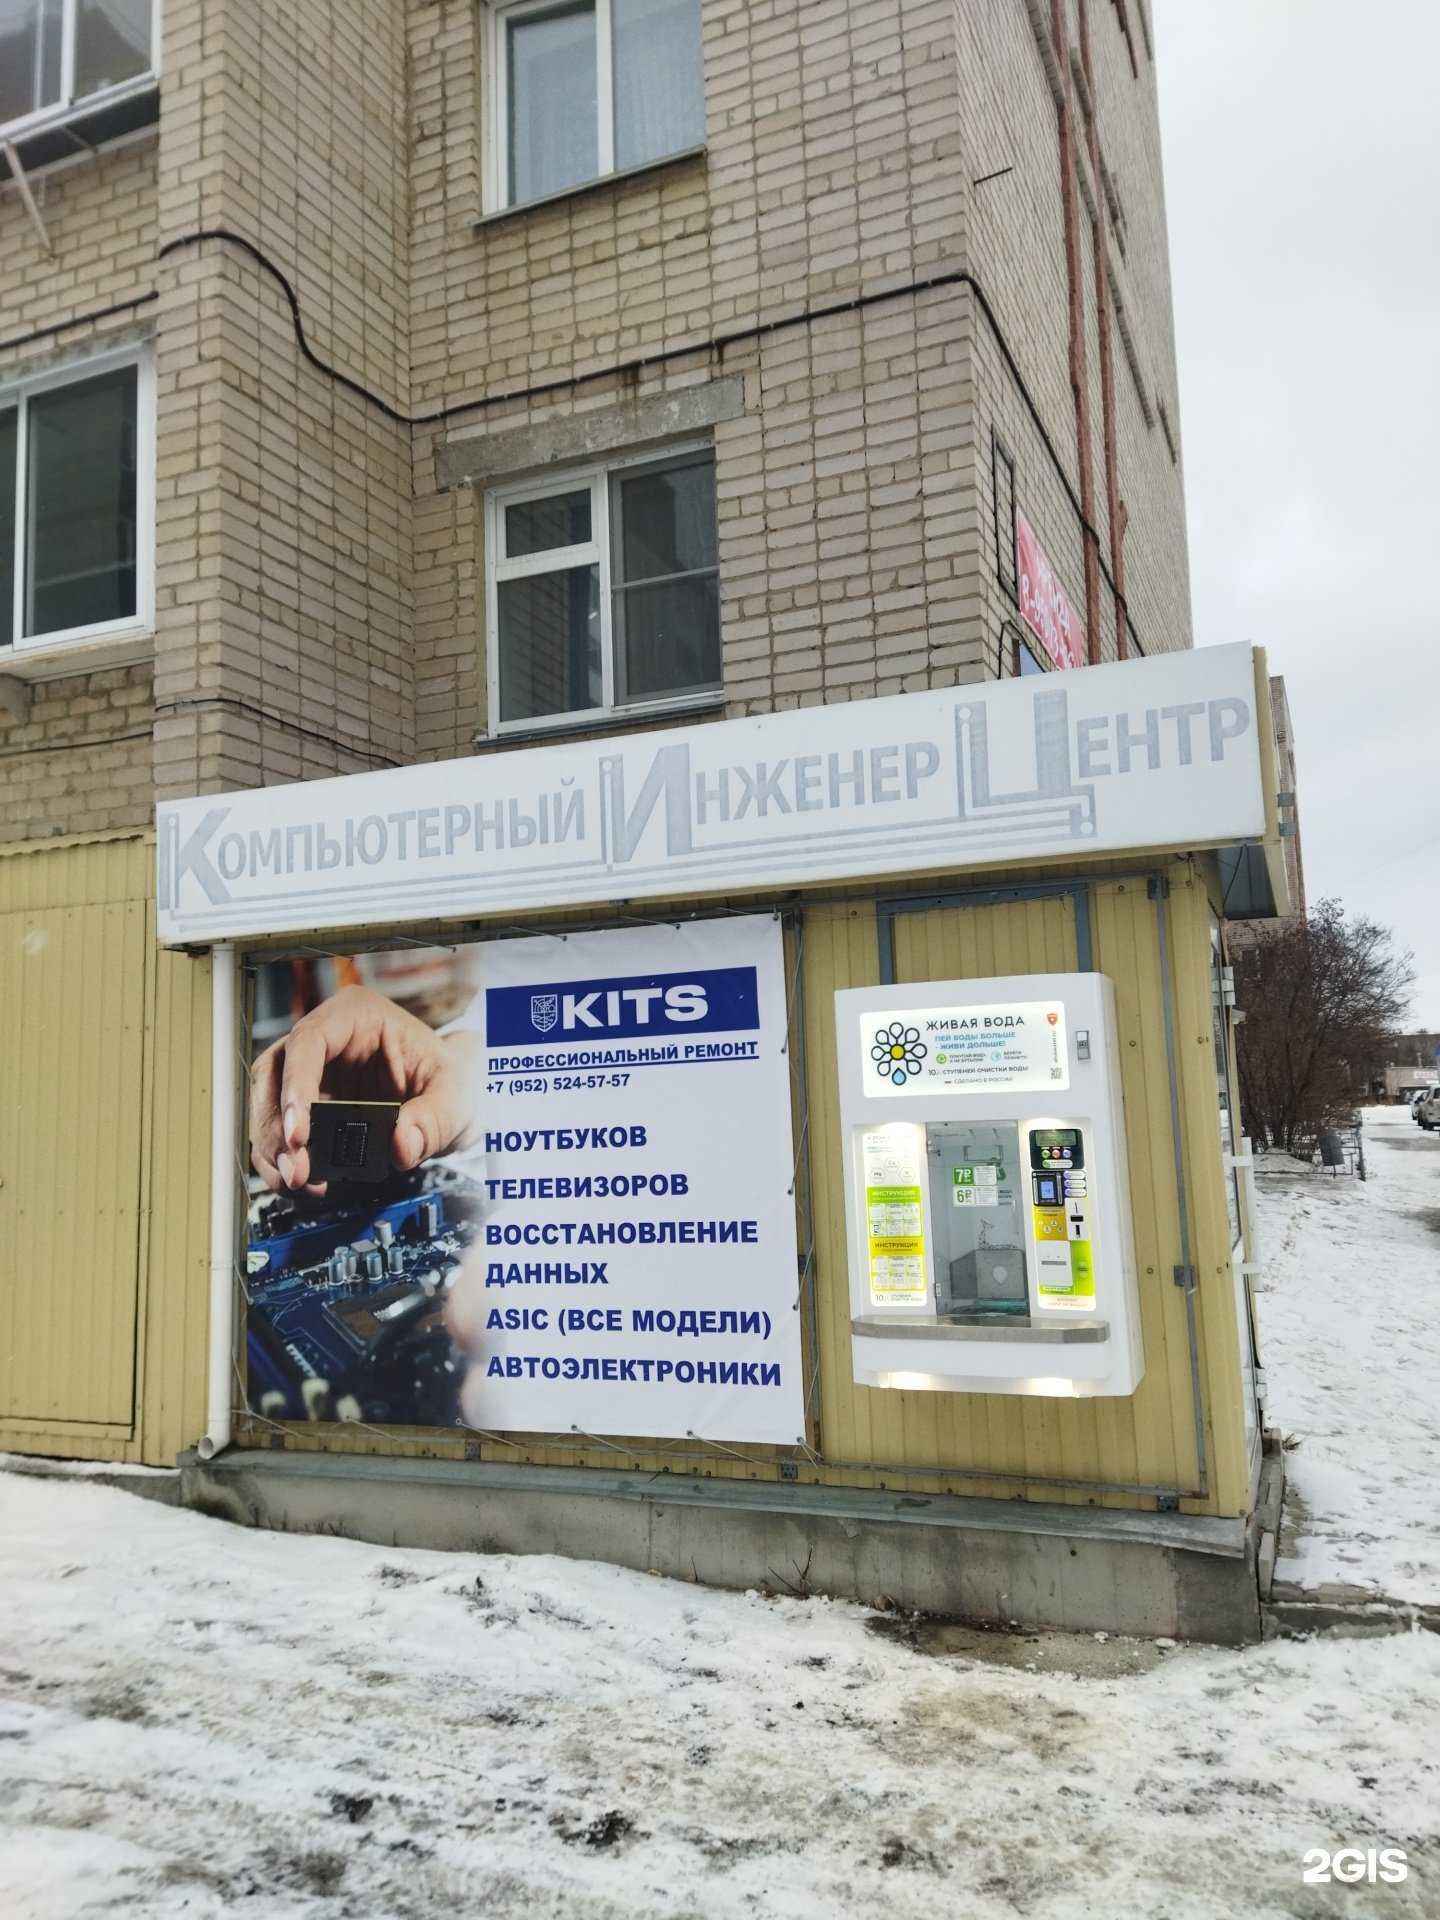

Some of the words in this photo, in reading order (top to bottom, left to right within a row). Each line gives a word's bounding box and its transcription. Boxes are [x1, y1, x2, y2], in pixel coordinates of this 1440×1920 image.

[158, 776, 586, 911] КОМПЬЮТЕРНЫЙ
[598, 742, 941, 868] ИНЖЕНЕР
[954, 689, 1251, 838] ЦЕНТР
[562, 984, 709, 1030] KITS
[926, 1018, 978, 1031] ЖИВАЯ
[984, 1016, 1025, 1028] ВОДА
[487, 1042, 679, 1071] ПРОФЕССИОНАЛЬНЫЙ
[684, 1041, 759, 1060] РЕМОНТ
[485, 1079, 504, 1094] +7
[509, 1077, 548, 1096] (952)
[553, 1073, 631, 1091] 524-57-57
[485, 1125, 648, 1153] НОУТБУКОВ
[485, 1173, 689, 1201] ТЕЛЕВИЗОРОВ
[486, 1221, 759, 1246] ВОССТАНОВЛЕНИЕ
[485, 1262, 609, 1289] ДАННЫХ
[486, 1308, 549, 1331] ASIC
[557, 1308, 623, 1336] (ВСЕ
[632, 1310, 772, 1340] МОДЕЛИ)
[487, 1356, 782, 1387] АВТОЭЛЕКТРОНИКИ
